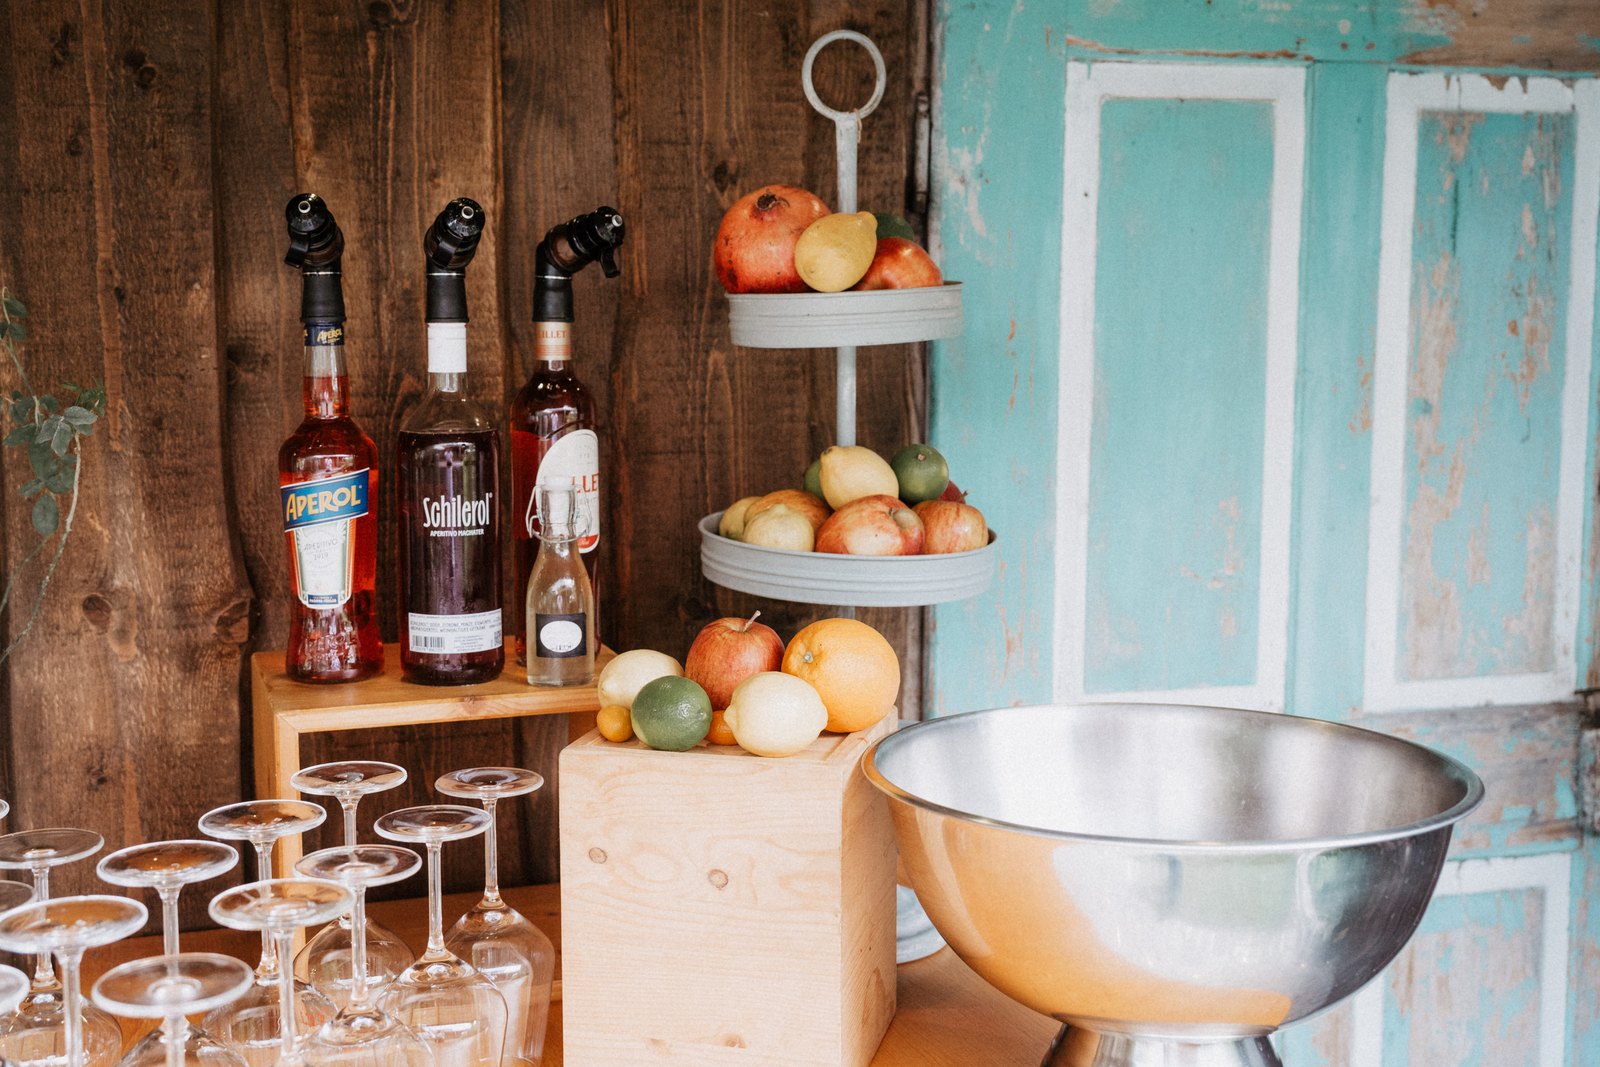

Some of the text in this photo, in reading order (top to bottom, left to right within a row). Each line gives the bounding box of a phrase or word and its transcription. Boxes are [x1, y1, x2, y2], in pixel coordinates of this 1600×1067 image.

[316, 328, 342, 342] APEROL
[286, 484, 361, 522] APEROL
[422, 492, 490, 528] Schilerol
